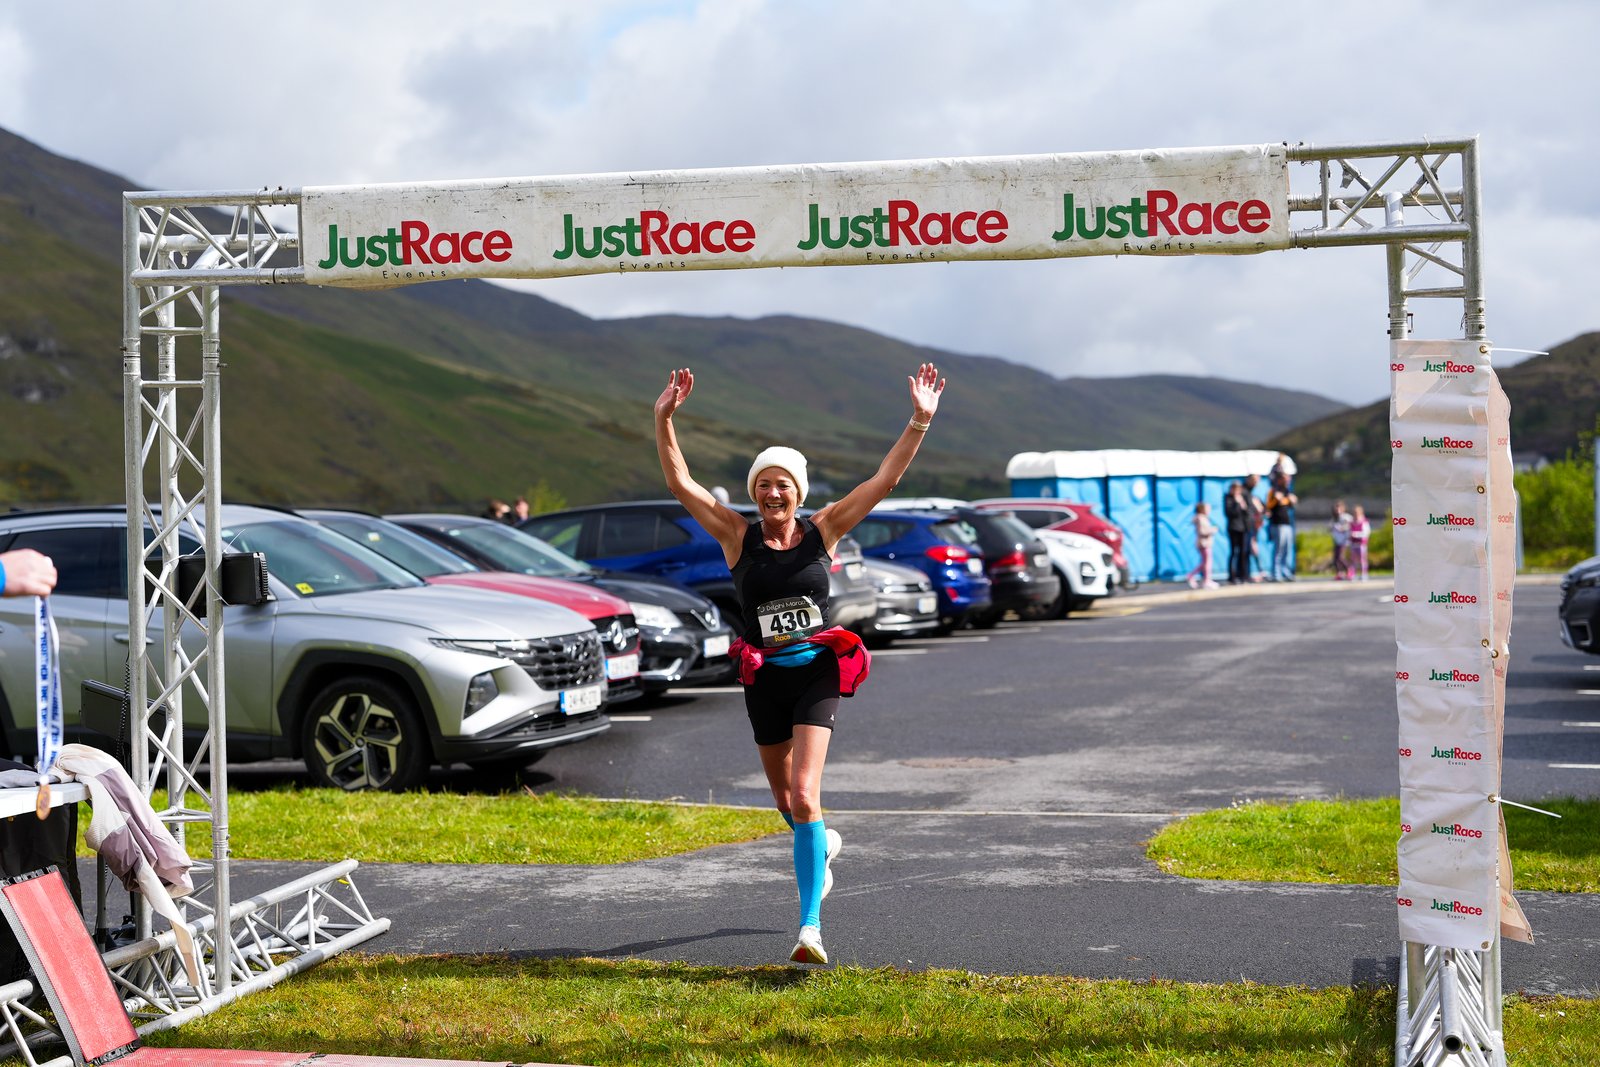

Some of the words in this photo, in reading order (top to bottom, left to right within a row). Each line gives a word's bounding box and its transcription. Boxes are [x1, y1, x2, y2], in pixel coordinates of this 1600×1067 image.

[1052, 190, 1271, 241] JustRace
[797, 200, 1008, 250] JustRace
[553, 211, 755, 259] JustRace
[318, 221, 512, 269] JustRace
[1124, 242, 1194, 252] Events
[867, 252, 935, 261] Events
[620, 261, 686, 270] Events
[383, 270, 446, 279] Events
[1423, 360, 1475, 373] JustRace
[1421, 437, 1473, 448] JustRace
[1427, 514, 1474, 526] JustRace
[1428, 592, 1476, 603] JustRace
[770, 610, 810, 633] 430
[1429, 669, 1480, 682] JustRace
[1431, 746, 1481, 760] JustRace
[1431, 823, 1482, 838] JustRace
[1431, 899, 1482, 915] JustRace
